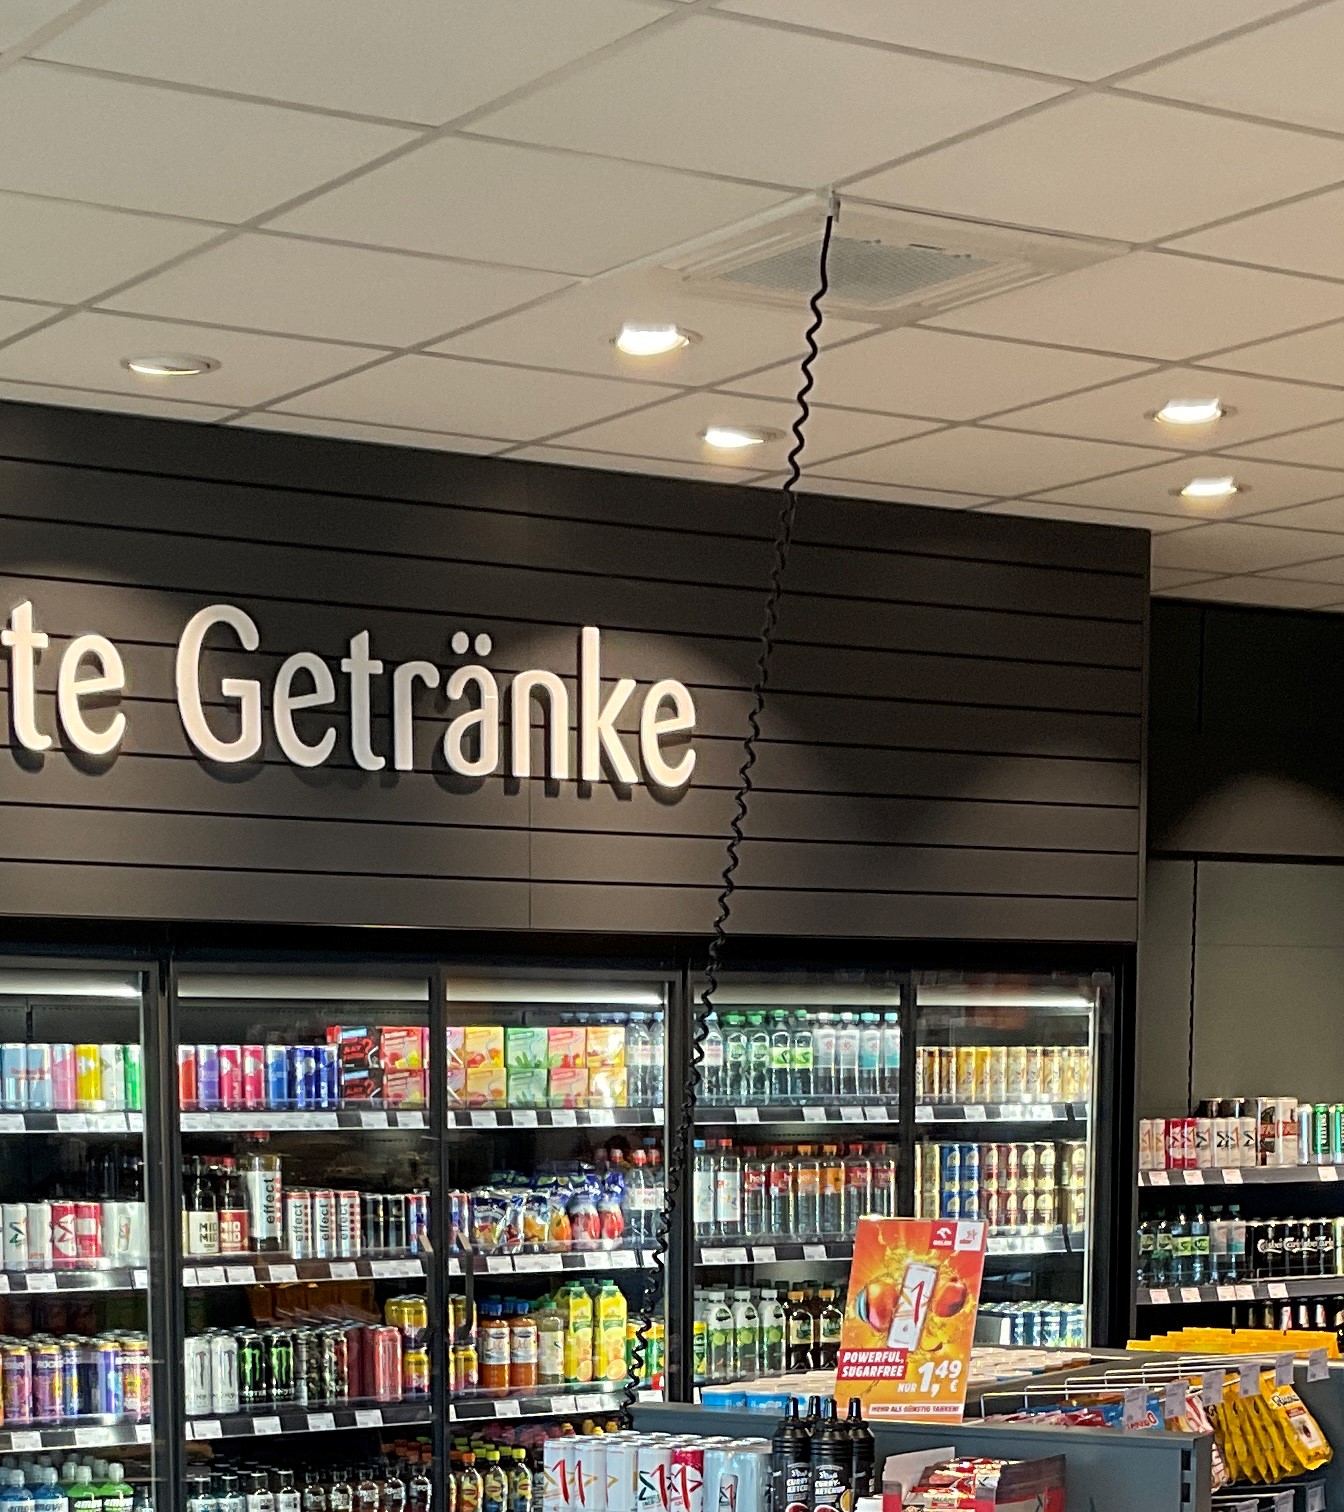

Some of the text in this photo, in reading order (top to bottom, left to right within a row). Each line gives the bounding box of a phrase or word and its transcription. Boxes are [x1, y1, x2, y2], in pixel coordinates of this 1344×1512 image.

[175, 605, 697, 790] Getränke
[265, 1176, 282, 1225] effect
[292, 1203, 303, 1243] effect
[319, 1203, 329, 1243] effect
[340, 1201, 351, 1241] effect
[842, 1365, 904, 1377] SUGARFREE
[843, 1351, 904, 1364] POWERFUL,
[897, 1383, 917, 1393] NUR
